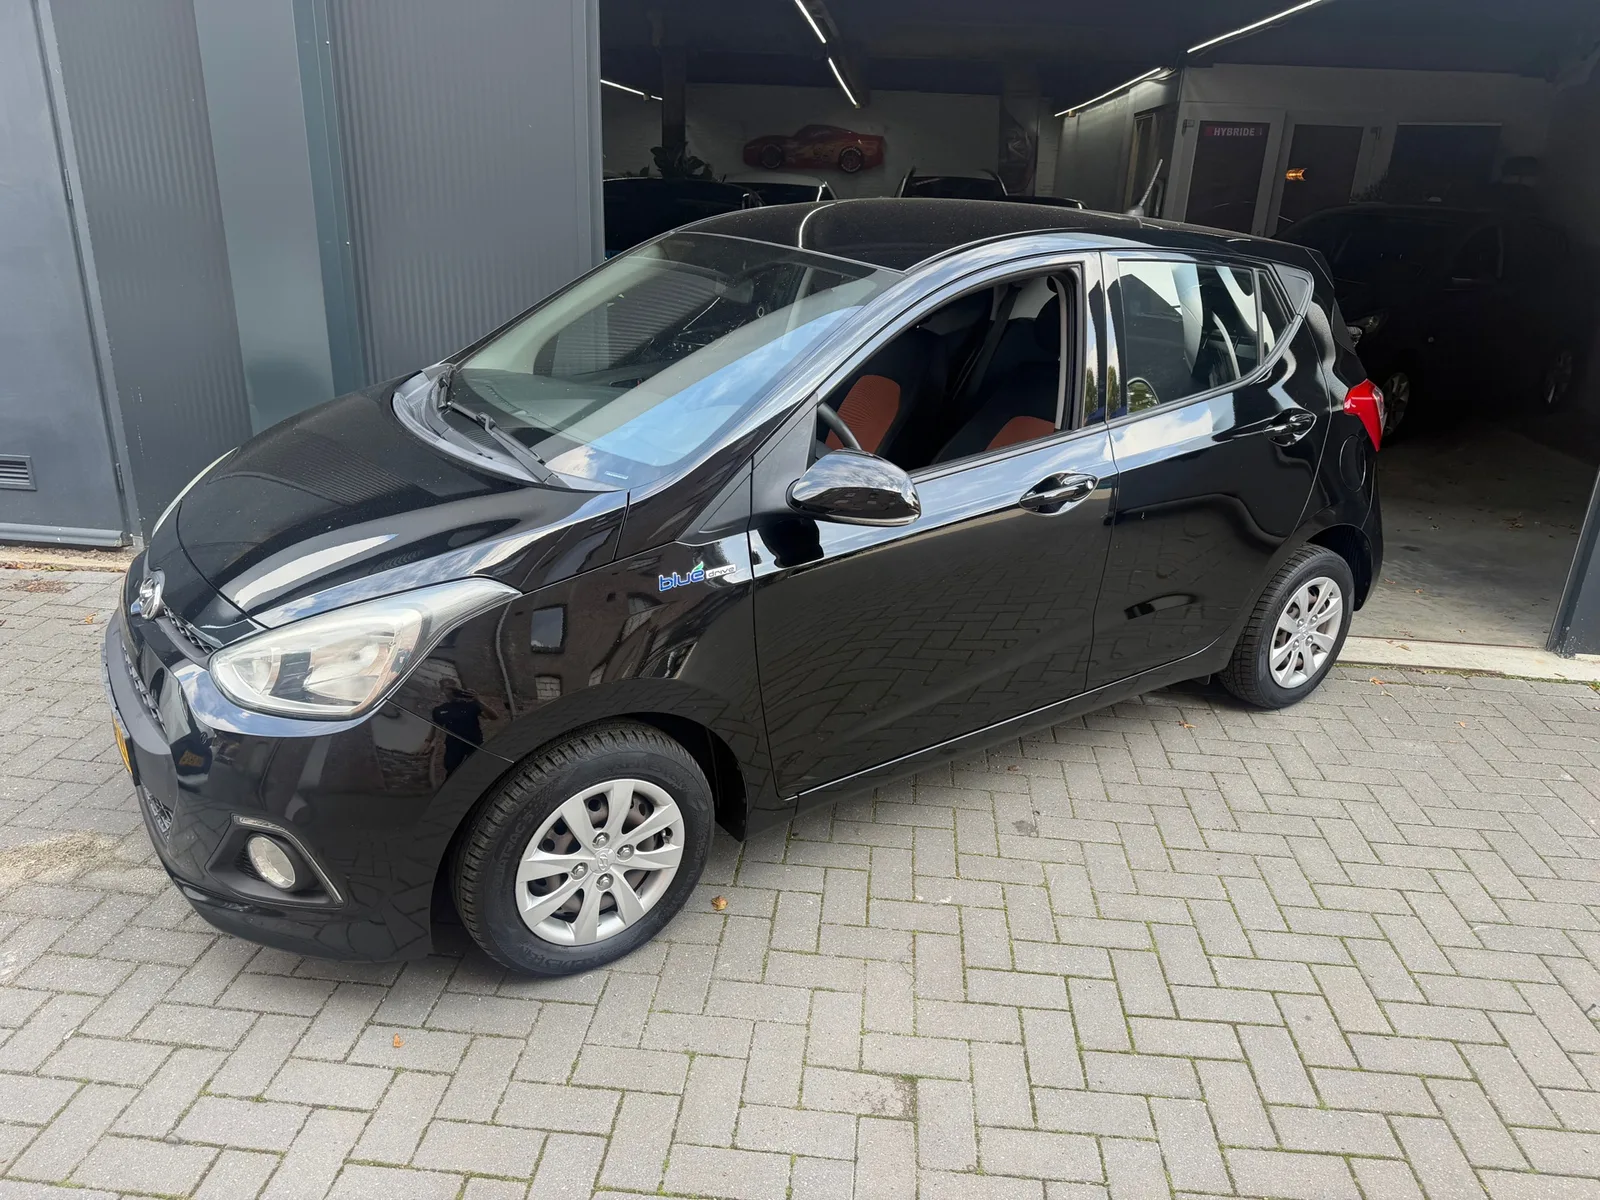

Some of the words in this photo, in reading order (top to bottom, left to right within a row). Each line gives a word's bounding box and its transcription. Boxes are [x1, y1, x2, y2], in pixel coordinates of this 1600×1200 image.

[1213, 127, 1255, 136] HYBRIDE
[659, 568, 704, 591] blue
[707, 566, 736, 578] drive
